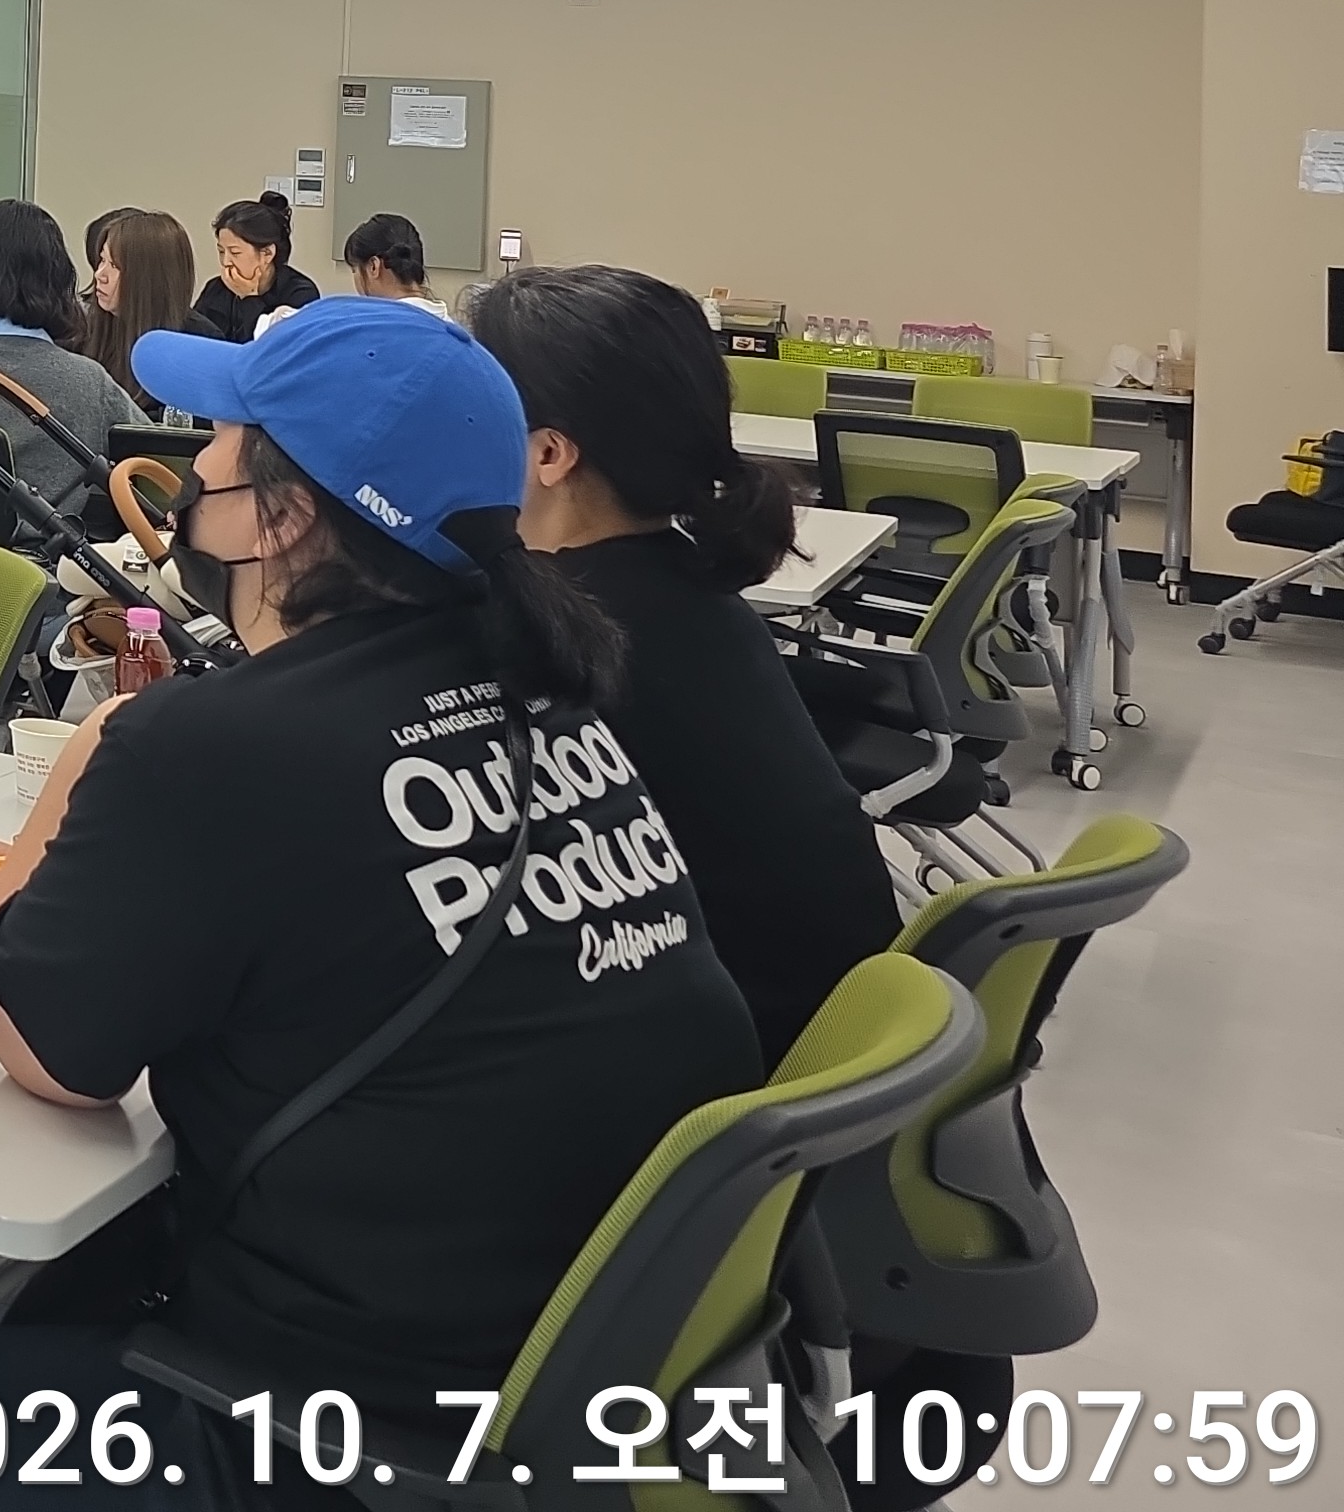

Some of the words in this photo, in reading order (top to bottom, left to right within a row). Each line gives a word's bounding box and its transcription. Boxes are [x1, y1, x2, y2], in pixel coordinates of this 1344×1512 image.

[423, 689, 463, 714] JUST
[460, 687, 475, 705] A
[390, 723, 431, 748] LOS
[428, 707, 496, 738] ANGELES
[577, 910, 687, 982] California
